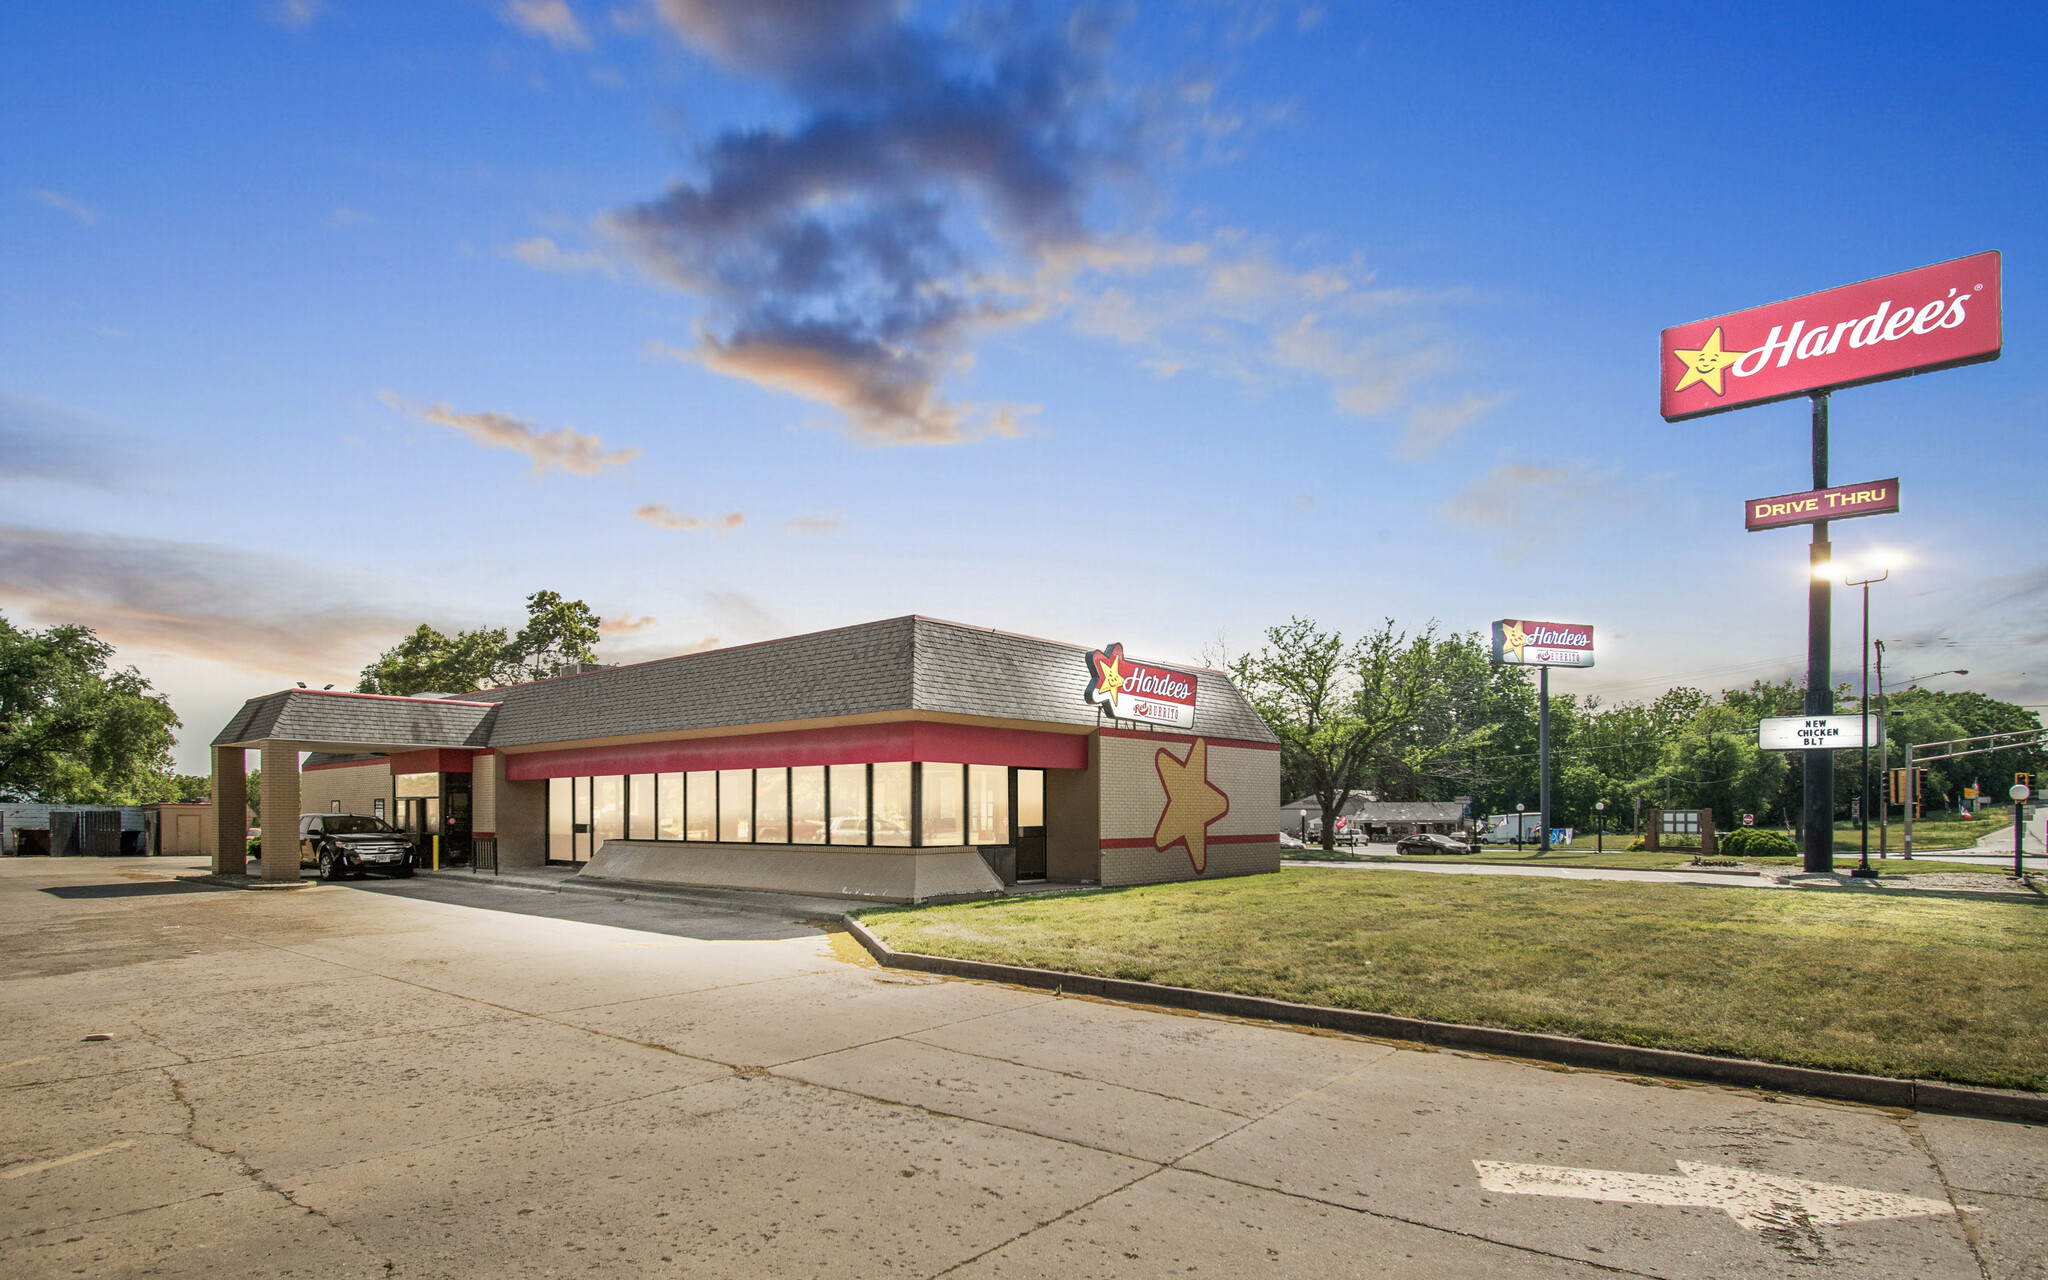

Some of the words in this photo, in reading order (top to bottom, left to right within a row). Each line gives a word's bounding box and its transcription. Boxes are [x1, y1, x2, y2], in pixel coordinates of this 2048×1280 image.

[1732, 287, 1971, 377] Hardee's
[1755, 497, 1819, 519] DRIVE
[1824, 487, 1886, 509] THRU
[1526, 627, 1590, 646] Hardee's
[1551, 653, 1579, 661] BURRITO
[1122, 667, 1192, 699] Hardee's
[1149, 704, 1179, 720] BURRITO
